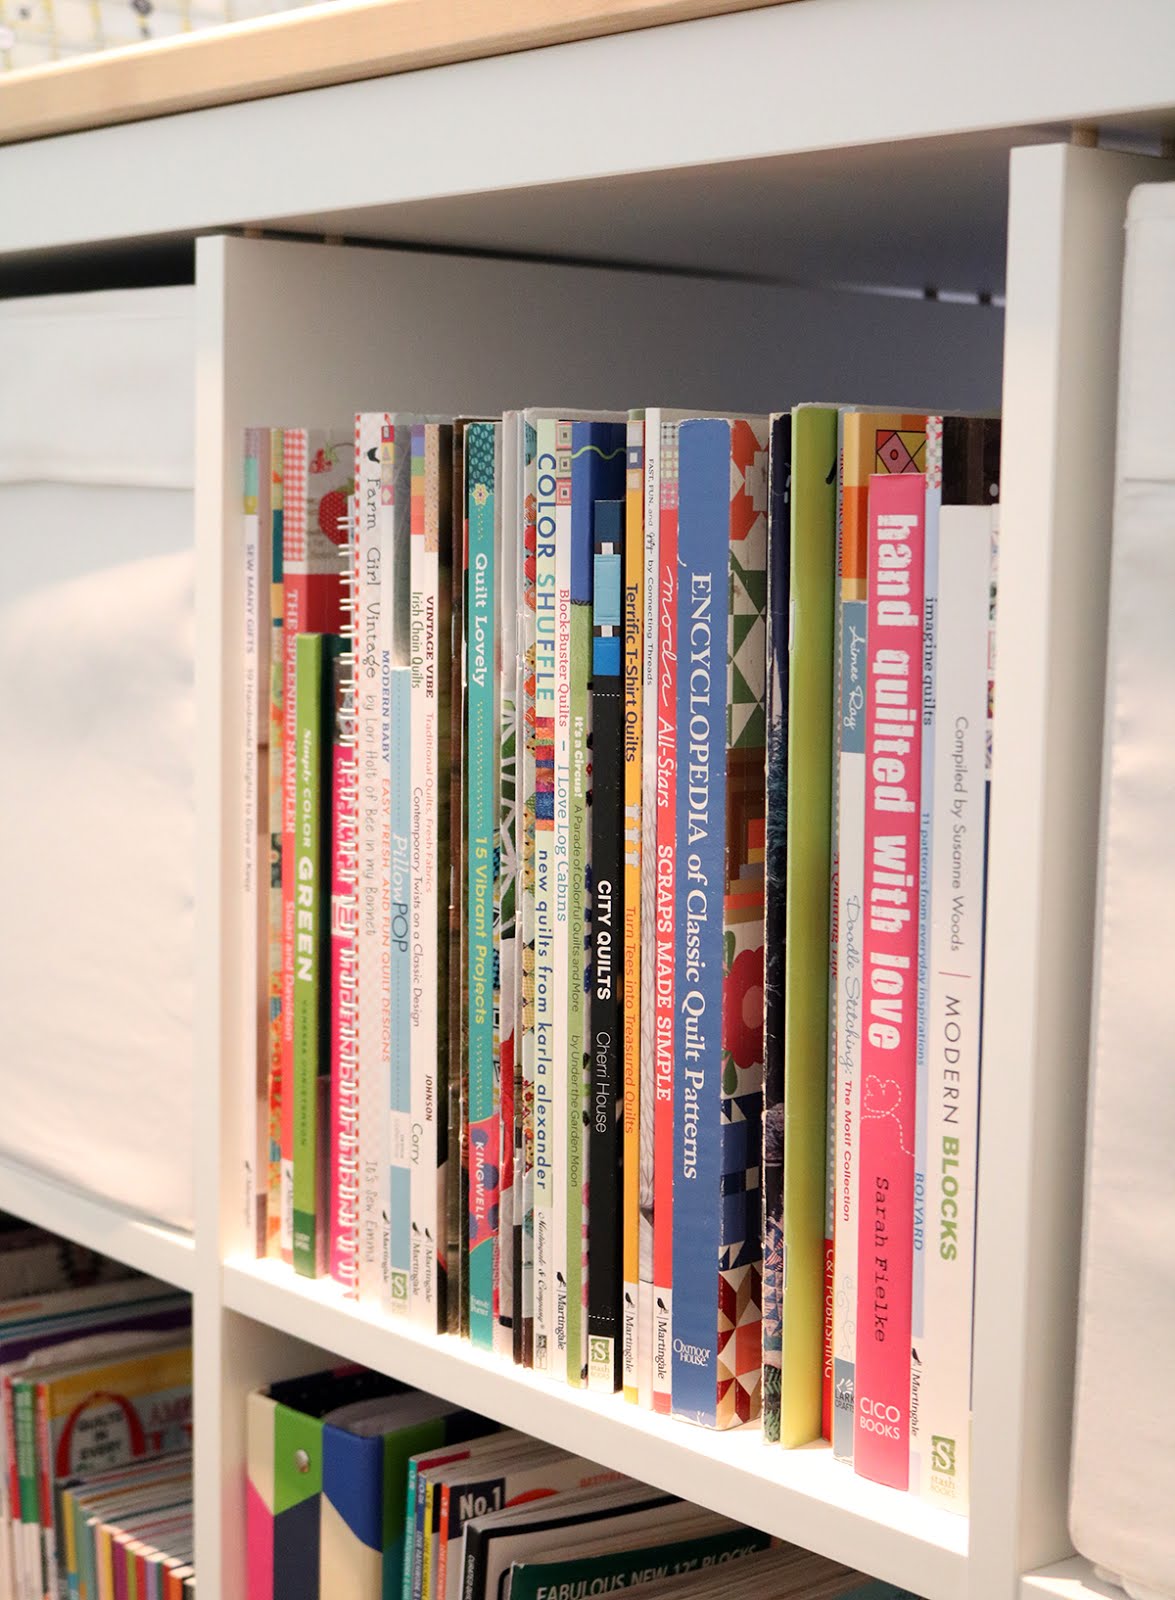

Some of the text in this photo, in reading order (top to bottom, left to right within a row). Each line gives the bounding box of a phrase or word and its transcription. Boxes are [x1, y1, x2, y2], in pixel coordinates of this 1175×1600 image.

[647, 458, 655, 482] FAST,
[647, 484, 655, 507] FUN,
[472, 553, 488, 688] Quilt Lovely
[536, 453, 556, 700] COLOR SHUFFLE
[646, 560, 654, 573] by
[646, 577, 655, 639] Connecting
[410, 591, 424, 689] Irish Chain Quilts
[624, 583, 639, 763] Terrific T-Shirt Quilts
[844, 626, 866, 731] Aimee Ray
[922, 596, 938, 726] imagine quilts
[286, 588, 299, 834] THE SPLENDID SAMPLER
[362, 478, 380, 937] Farm Girl Vintage by Lori Holt of Bee in my Bonnet
[424, 596, 435, 894] VINTAGE VIBE Traditional Quilts, Fresh Fabrics
[556, 590, 570, 921] Block-Buster Quilts I Love Log Cabins
[574, 716, 583, 798] It's a Circus!
[656, 566, 678, 1101] moda All-Stars SCRAPS MADE SIMPLE
[868, 514, 919, 1051] hand quilted with love
[951, 716, 969, 952] Compiled by Susanne Woods
[298, 727, 314, 982] Simply COLOR GREEN
[380, 649, 391, 1062] MODERN BABY EASY, FRESH, AND FUN QUILT DESIGNS
[411, 787, 424, 1028] Contemporary Twists on a Classic Design
[571, 804, 582, 1013] A Parade of Colorful Quilts and More
[681, 572, 712, 1180] ENCYCLOPEDIA of Classic Quilt Patterns
[284, 900, 294, 1042] Sloan and Davidson
[471, 836, 488, 1024] 15 Vibrant Projects
[596, 880, 612, 1001] CITY QUILTS
[915, 812, 931, 1066] 11 patterns from everyday inspirations
[536, 850, 553, 1190] new quilts from karla alexander
[624, 905, 637, 1134] Turn Tees into Treasured Quilts
[839, 895, 861, 1223] Doodle Stitching: The Motif Collection
[425, 1074, 433, 1122] JOHNSON
[570, 1034, 580, 1188] by Under the Garden Moon
[595, 1031, 611, 1134] Cherri House
[940, 995, 961, 1262] MODERN BLOCKS
[411, 1122, 424, 1165] Corry
[475, 1141, 485, 1221] KINGWELL
[365, 1160, 378, 1264] It's Sew Emma
[411, 1241, 421, 1296] Martingale
[537, 1211, 546, 1265] Martingale
[874, 1177, 890, 1343] Sarah Fielke
[914, 1171, 925, 1251] BOLYARD
[424, 1248, 433, 1303] Martingale
[557, 1294, 567, 1349] Martingale
[624, 1314, 634, 1374] Martingale
[655, 1320, 667, 1380] Martingale
[673, 1338, 711, 1359] Oxmoor
[859, 1416, 900, 1440] BOOKS
[860, 1397, 901, 1423] CICO
[909, 1373, 921, 1438] Martingale
[458, 1485, 502, 1521] No.1
[535, 1564, 669, 1600] FABULOUS NEW
